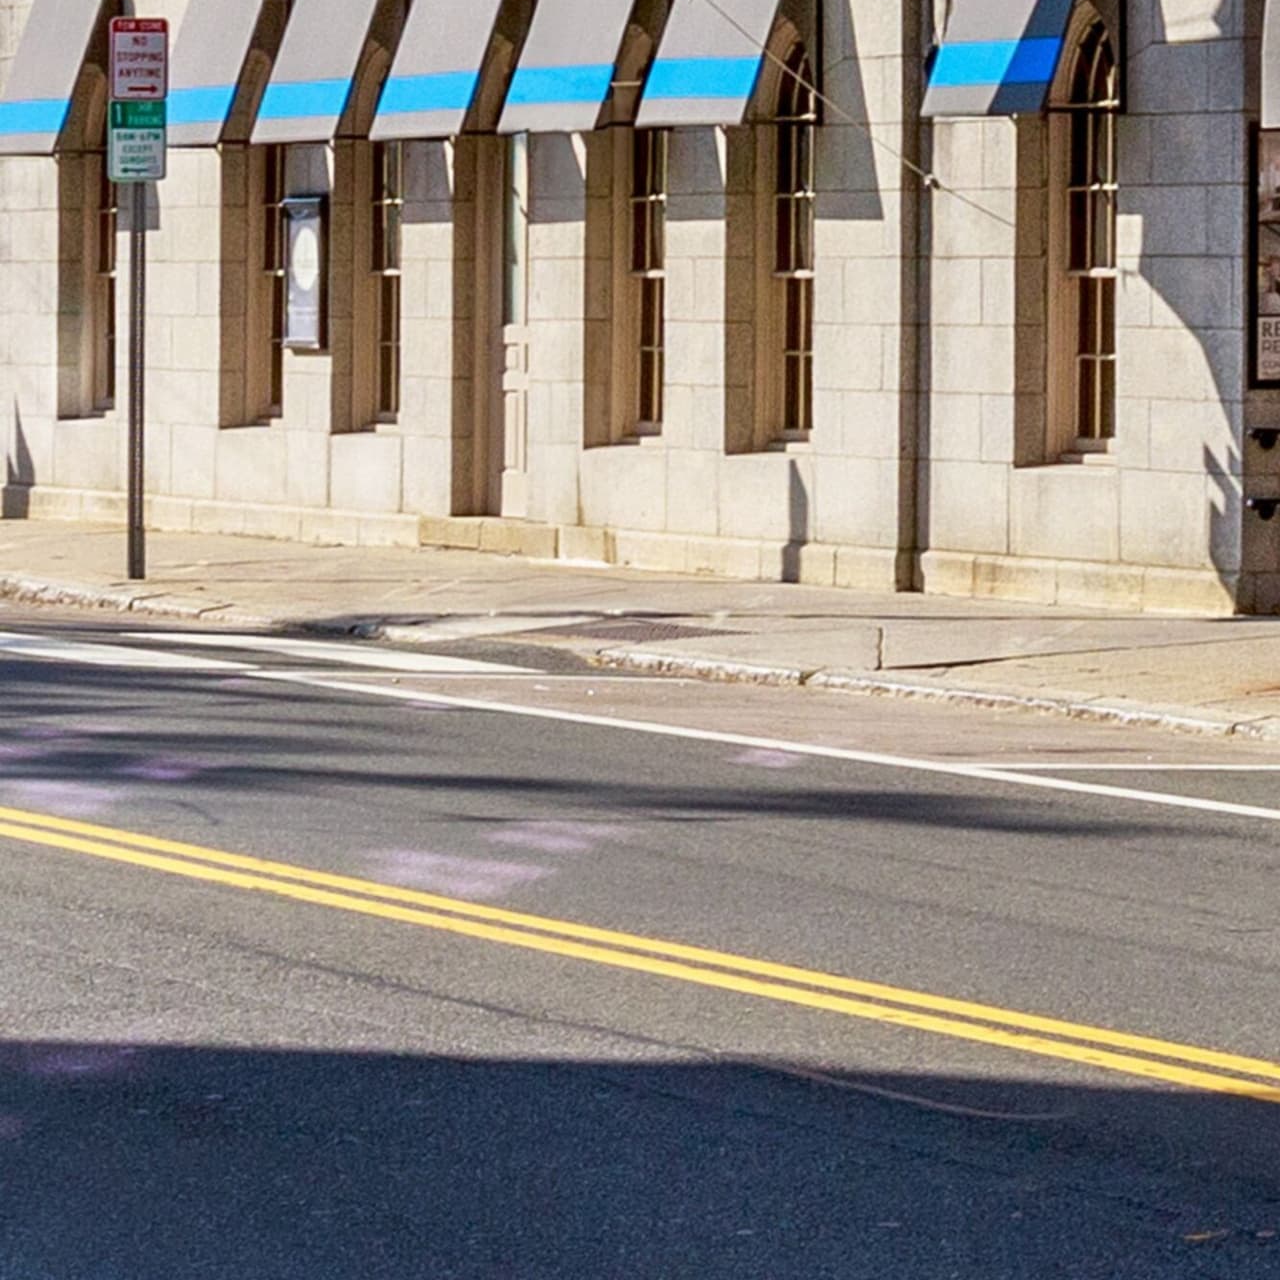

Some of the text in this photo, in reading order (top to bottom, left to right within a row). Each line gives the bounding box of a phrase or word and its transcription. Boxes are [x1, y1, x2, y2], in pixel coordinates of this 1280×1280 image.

[133, 36, 147, 46] NO
[117, 52, 163, 62] STOPPING
[119, 68, 161, 78] ANYTIME
